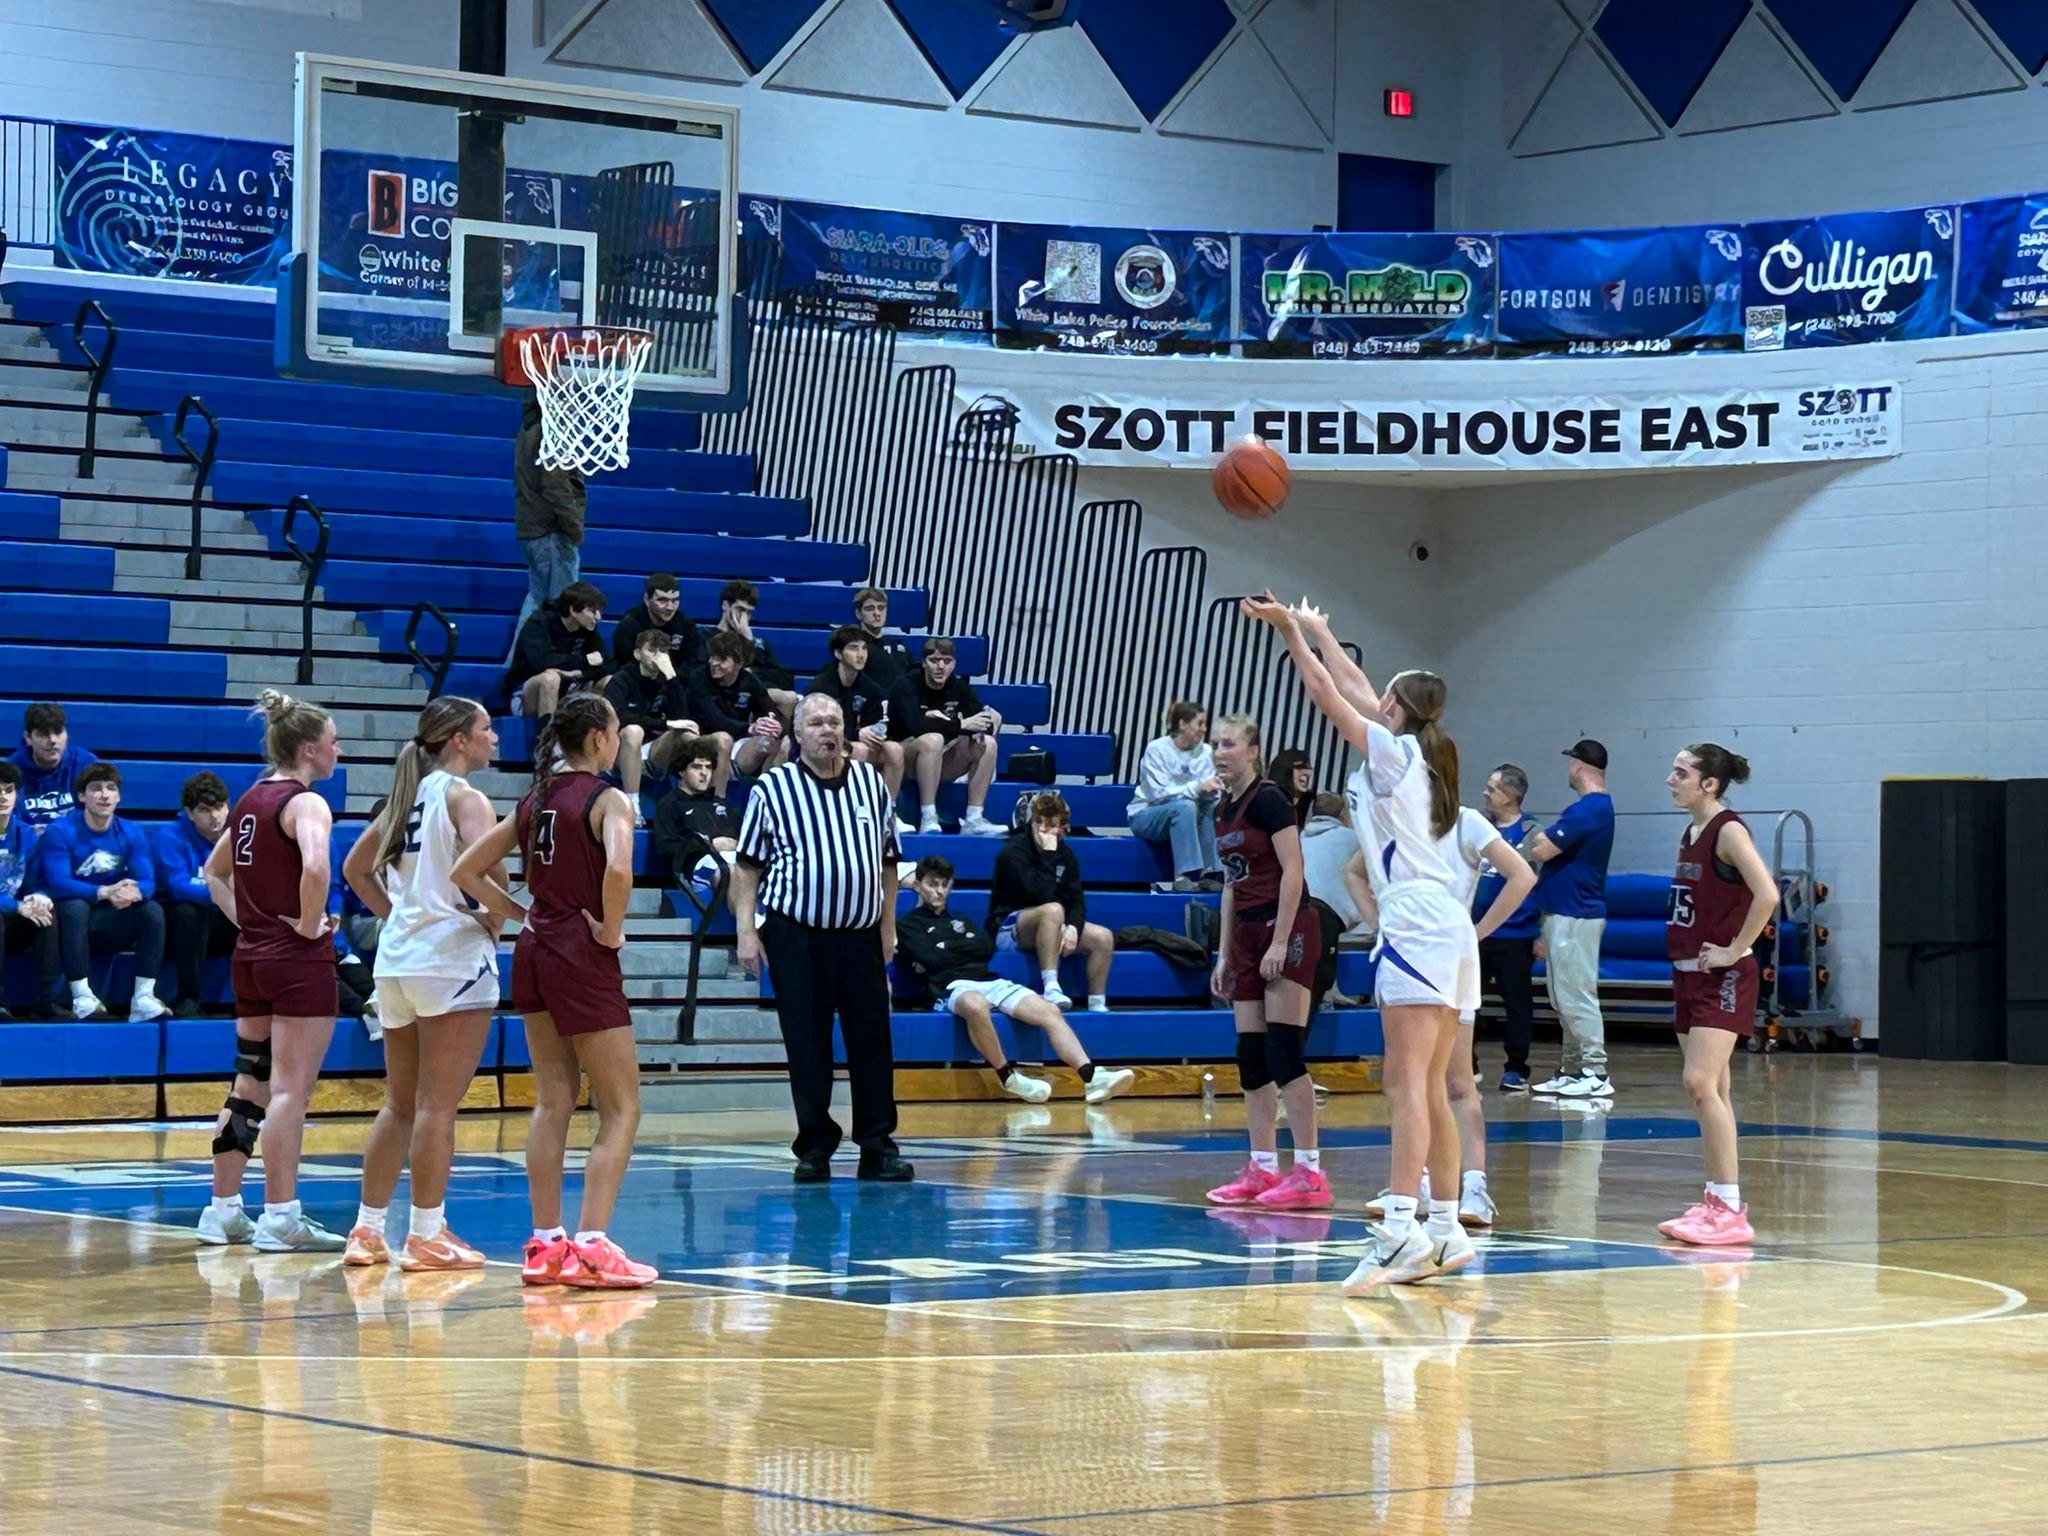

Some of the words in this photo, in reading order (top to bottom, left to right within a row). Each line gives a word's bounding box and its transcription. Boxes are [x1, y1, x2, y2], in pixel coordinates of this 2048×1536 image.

[122, 155, 286, 198] LEGACY
[242, 203, 291, 220] GROU
[381, 249, 442, 273] White
[1759, 237, 1934, 312] Culligan
[359, 270, 404, 286] Corner
[407, 275, 420, 289] of
[1264, 272, 1344, 302] MR.
[1499, 288, 1592, 310] FORTSON
[1632, 282, 1742, 308] DENTISTRY
[1015, 307, 1049, 323] White
[1053, 310, 1086, 328] Lake
[1089, 313, 1128, 330] Police
[1131, 315, 1212, 332] Foundation
[1053, 402, 1235, 453] SZOTT
[1252, 406, 1622, 456] FIELDHOUSE
[1639, 401, 1780, 452] EAST
[235, 814, 257, 866] 2
[534, 809, 557, 865] 4
